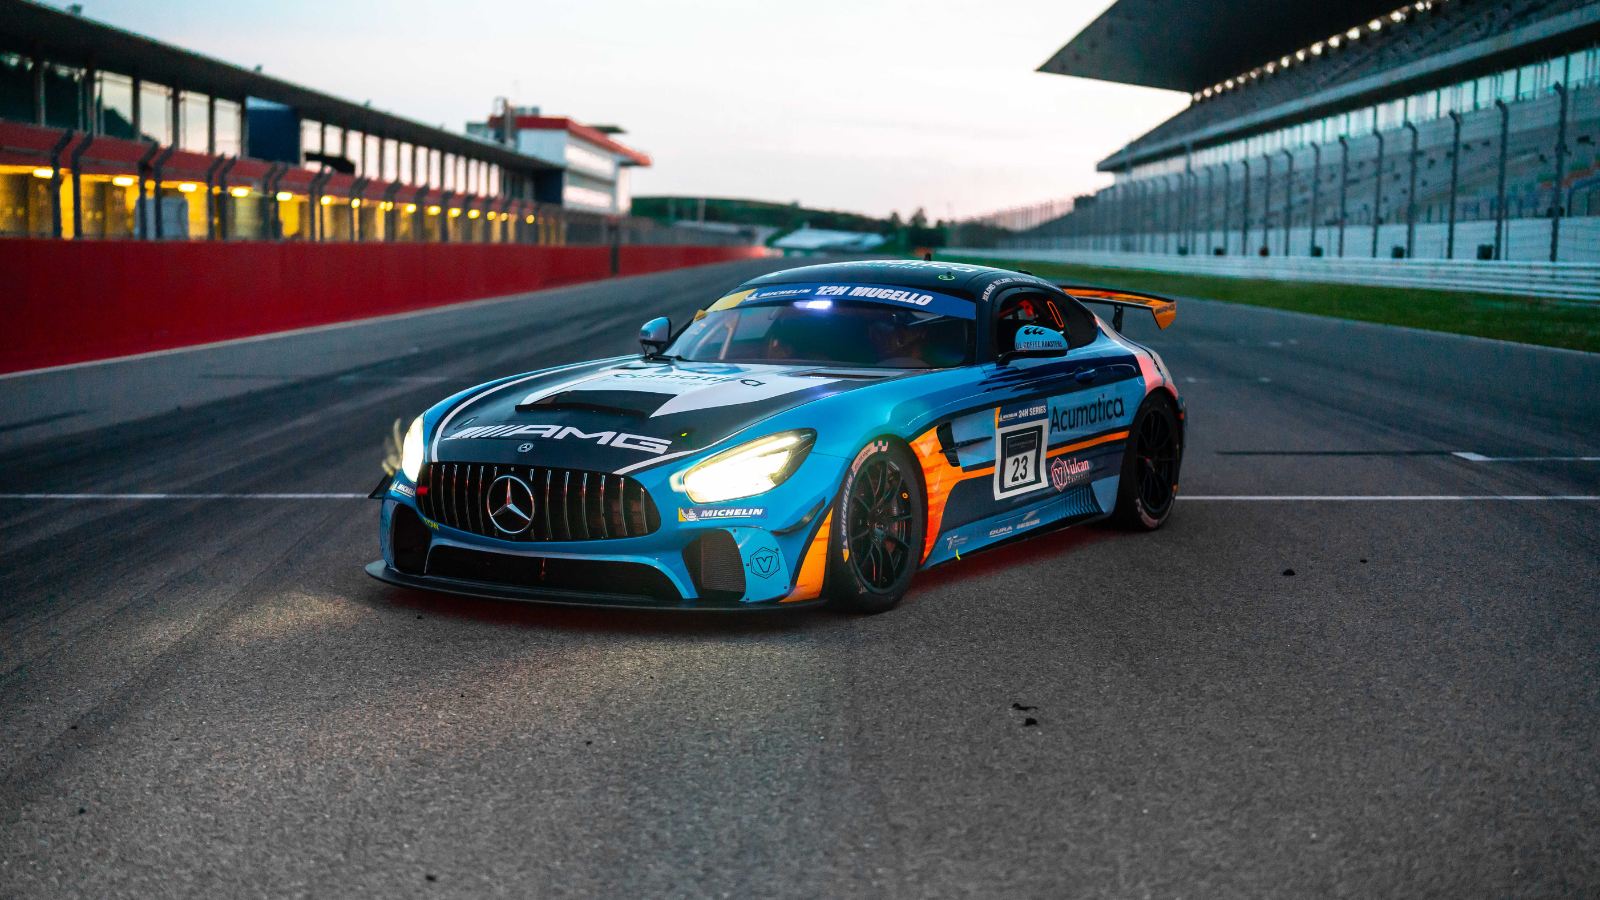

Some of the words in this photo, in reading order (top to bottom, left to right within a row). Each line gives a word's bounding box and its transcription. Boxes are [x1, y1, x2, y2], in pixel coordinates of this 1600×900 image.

[815, 285, 850, 296] 12H
[848, 286, 934, 306] MUGELLO
[1029, 405, 1047, 416] SERIES
[1049, 393, 1125, 435] Acumatica
[1011, 455, 1029, 483] 23
[700, 508, 764, 518] MICHELIN
